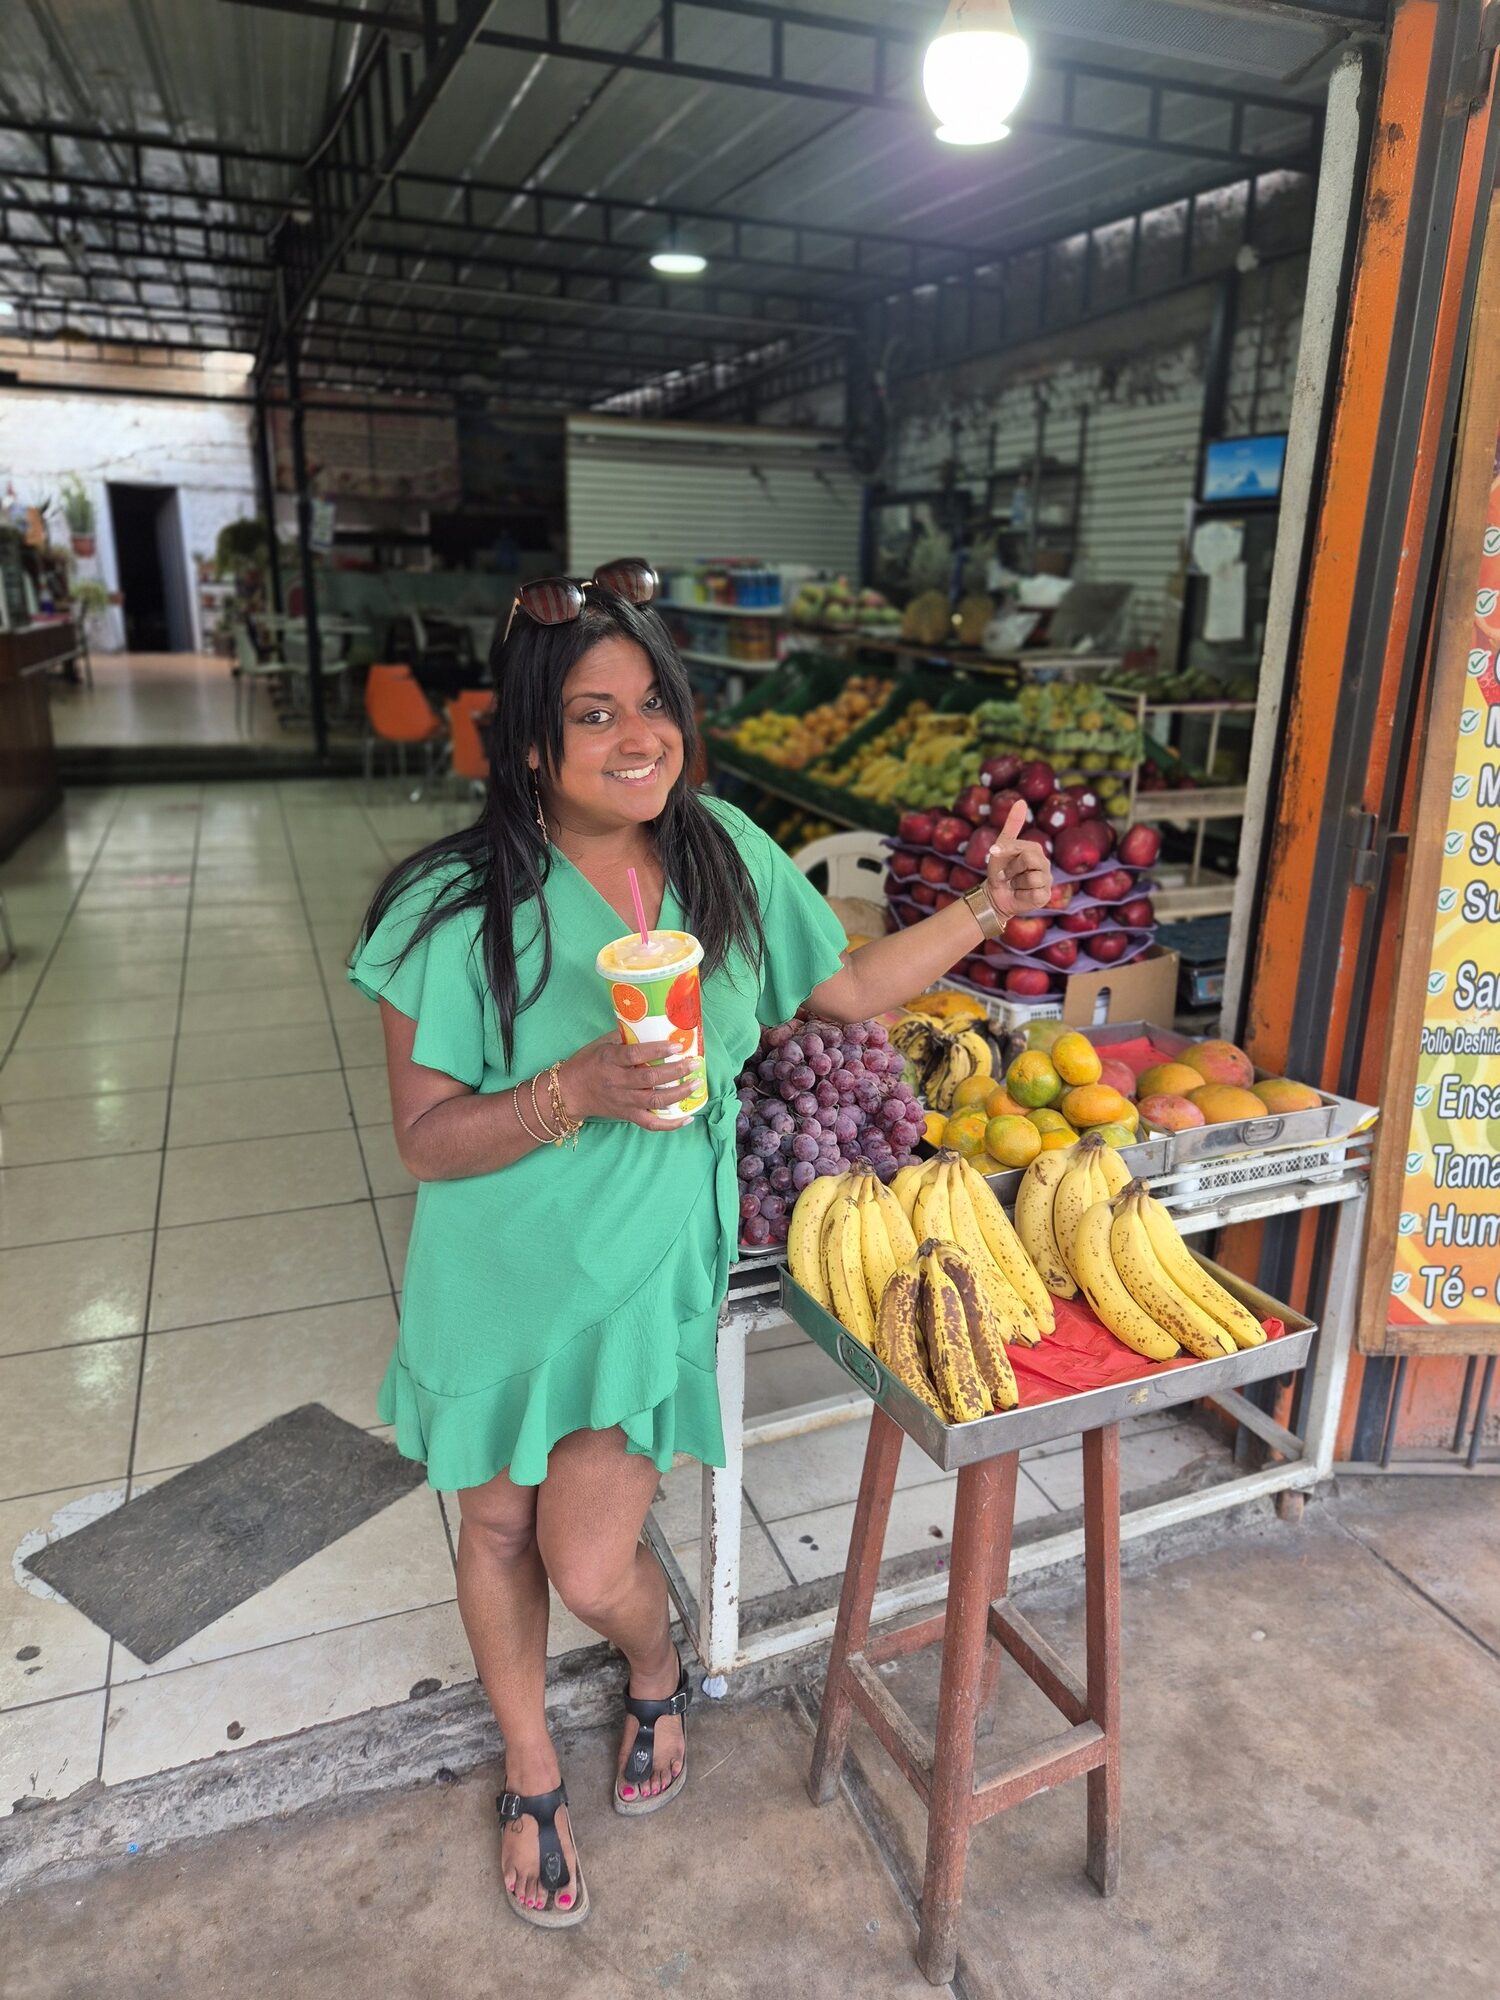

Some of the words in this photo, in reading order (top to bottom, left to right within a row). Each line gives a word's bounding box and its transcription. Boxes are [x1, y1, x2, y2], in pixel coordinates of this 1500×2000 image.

[1453, 959, 1500, 1011] Sa
[1419, 1026, 1452, 1055] Pollo
[1432, 1143, 1500, 1189] Tama
[1425, 1202, 1500, 1248] Hum
[1419, 1265, 1466, 1309] Té
